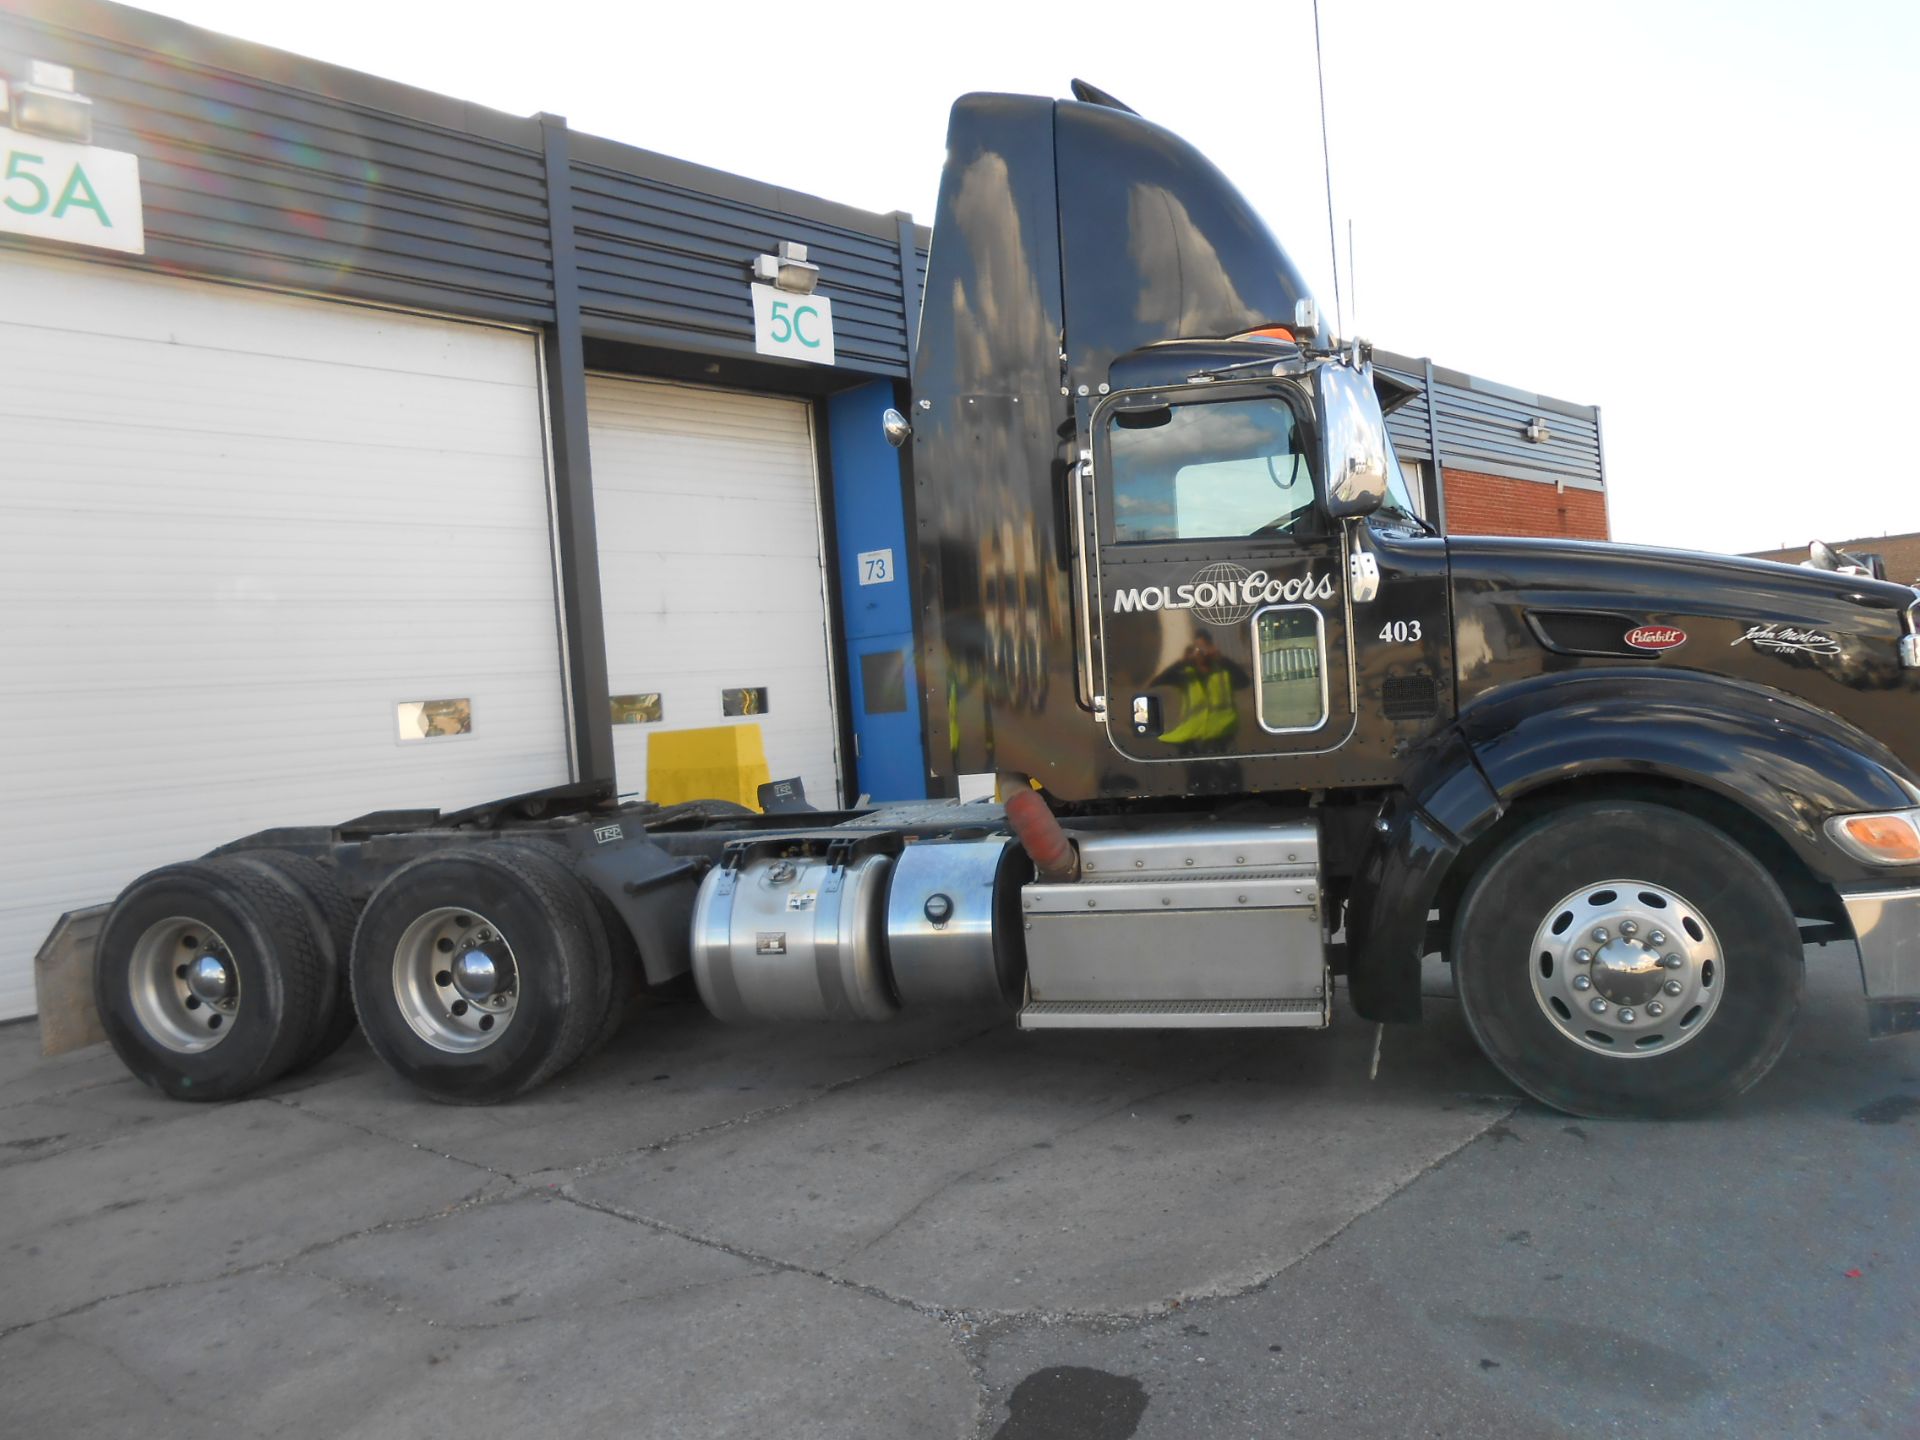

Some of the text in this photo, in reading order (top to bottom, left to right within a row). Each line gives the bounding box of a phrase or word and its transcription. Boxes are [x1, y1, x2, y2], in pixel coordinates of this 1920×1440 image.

[3, 150, 113, 228] 5A
[770, 300, 821, 349] 5C
[865, 558, 886, 580] 73
[1113, 570, 1336, 613] MOLSON Coors
[1379, 620, 1423, 643] 403
[1631, 629, 1681, 643] Peterbilt
[596, 826, 622, 841] TRP
